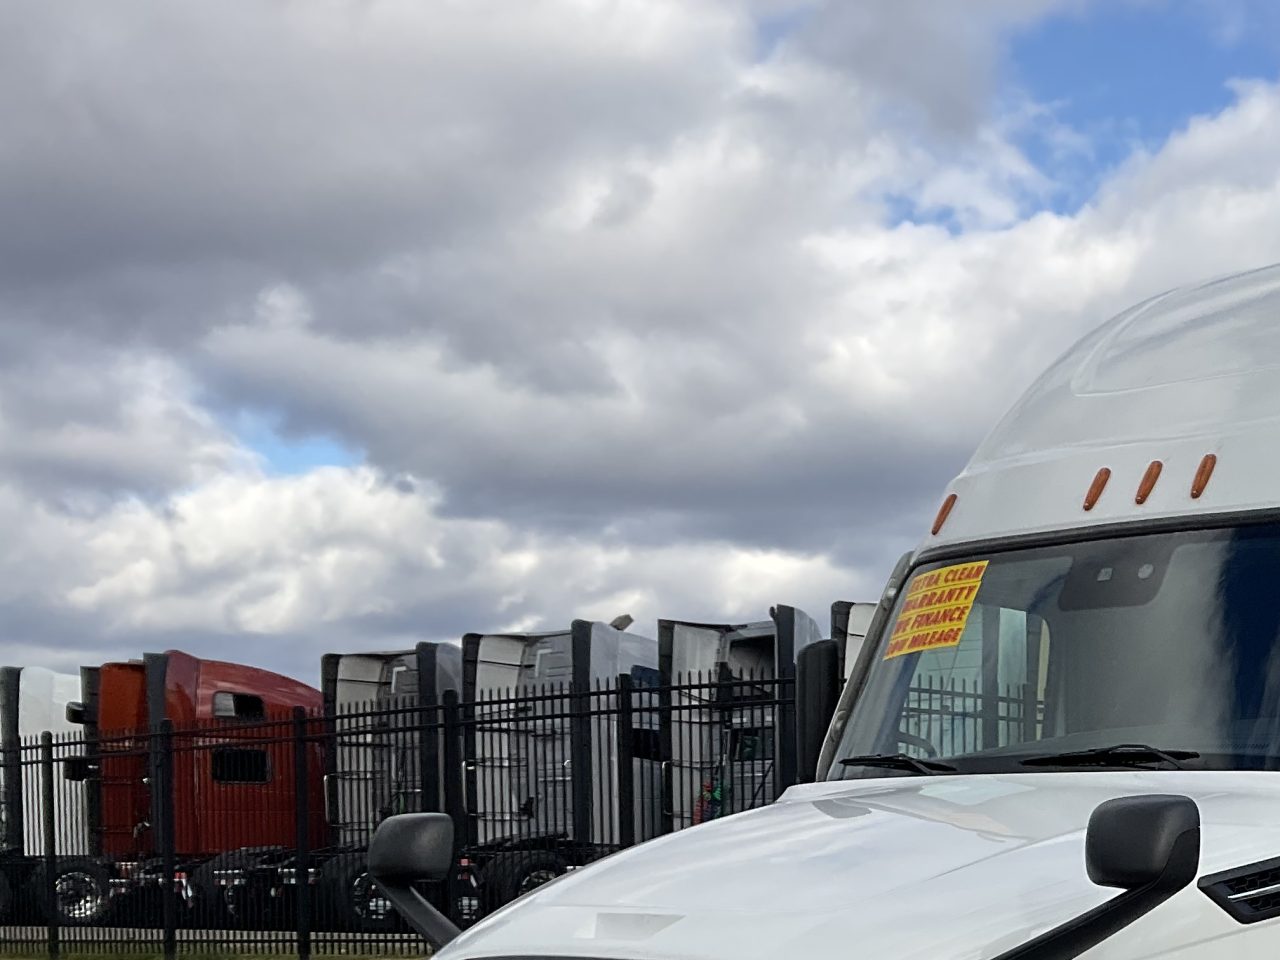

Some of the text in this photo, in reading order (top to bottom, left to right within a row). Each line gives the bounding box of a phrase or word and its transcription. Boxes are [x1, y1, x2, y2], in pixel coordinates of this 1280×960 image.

[944, 564, 985, 583] CLEAN
[902, 585, 977, 613] WARRANTY
[911, 605, 969, 630] FINANCE
[908, 627, 963, 649] MILEAGE
